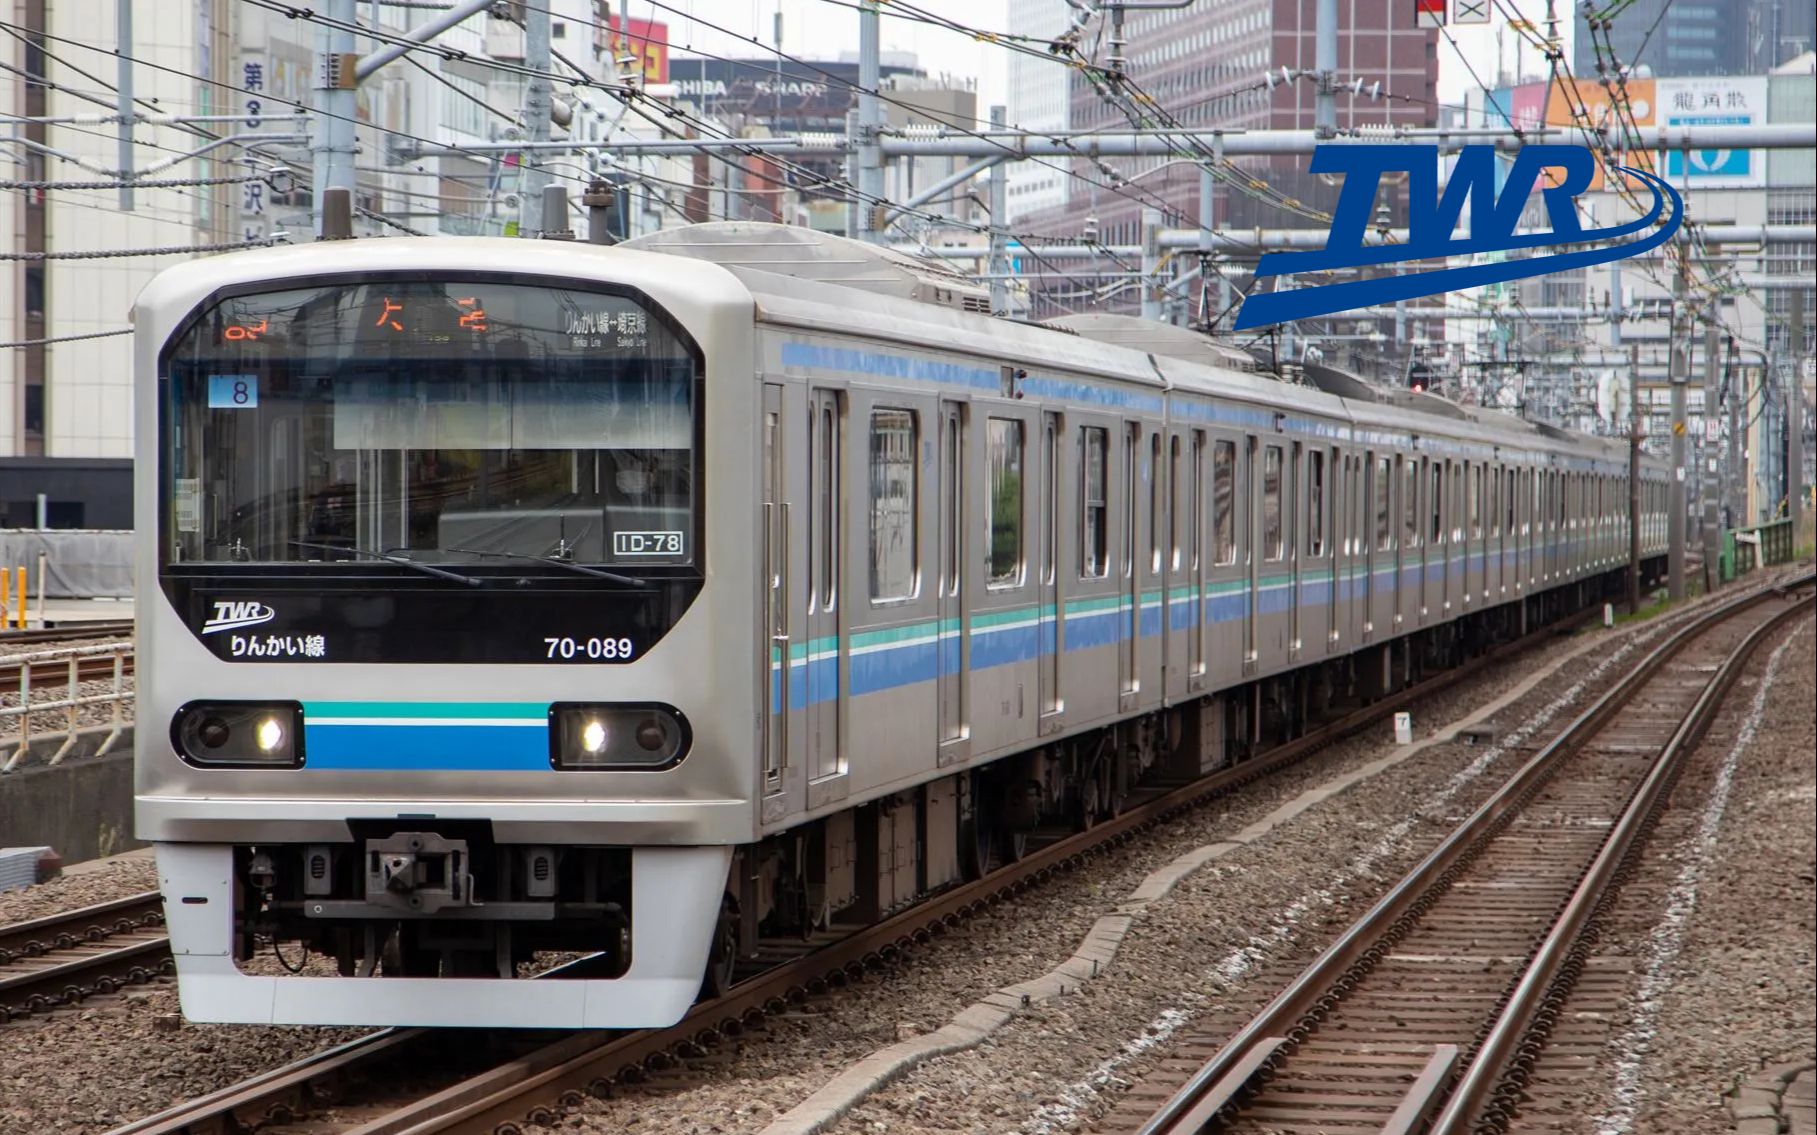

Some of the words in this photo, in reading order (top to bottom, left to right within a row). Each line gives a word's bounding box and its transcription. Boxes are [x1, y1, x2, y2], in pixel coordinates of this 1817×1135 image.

[671, 80, 727, 97] SHIBA
[754, 80, 828, 97] SHARP
[1673, 89, 1749, 112] 龍角散
[232, 380, 250, 405] 8
[621, 534, 680, 552] ID-78
[231, 634, 326, 658] りんかい線
[543, 636, 633, 660] 70-089
